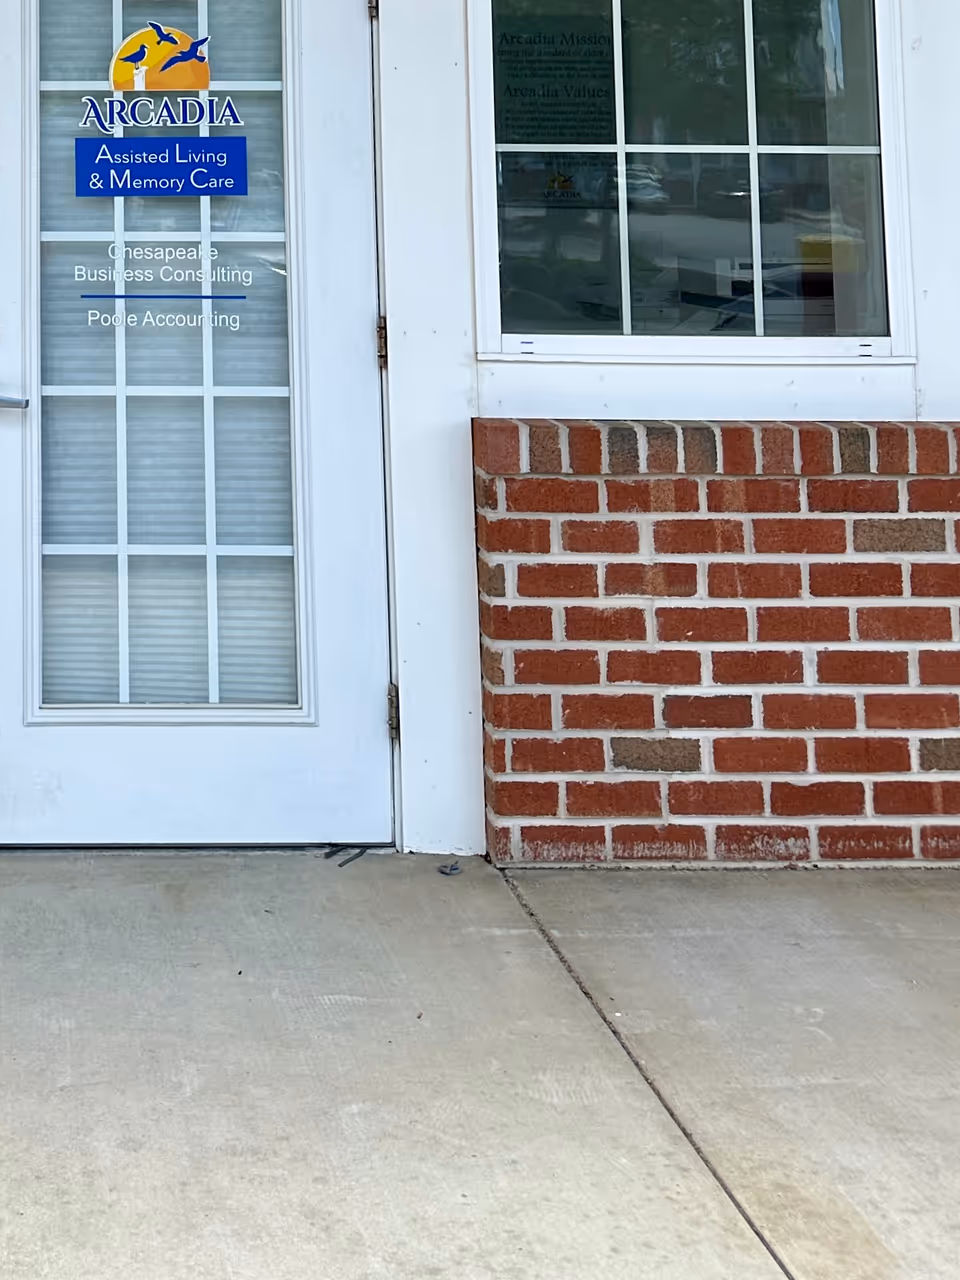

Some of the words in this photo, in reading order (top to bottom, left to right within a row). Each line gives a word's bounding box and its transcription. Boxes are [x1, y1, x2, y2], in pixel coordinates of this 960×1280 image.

[79, 96, 245, 134] ARCADIA
[95, 144, 169, 164] Assisted
[175, 144, 227, 166] Living
[89, 173, 104, 189] &
[110, 170, 185, 192] Memory
[190, 169, 234, 188] Care
[108, 244, 218, 263] Chesapeake
[75, 265, 154, 282] Business
[159, 265, 253, 285] Consulting
[87, 311, 138, 328] Poole
[142, 311, 240, 331] Accounting
